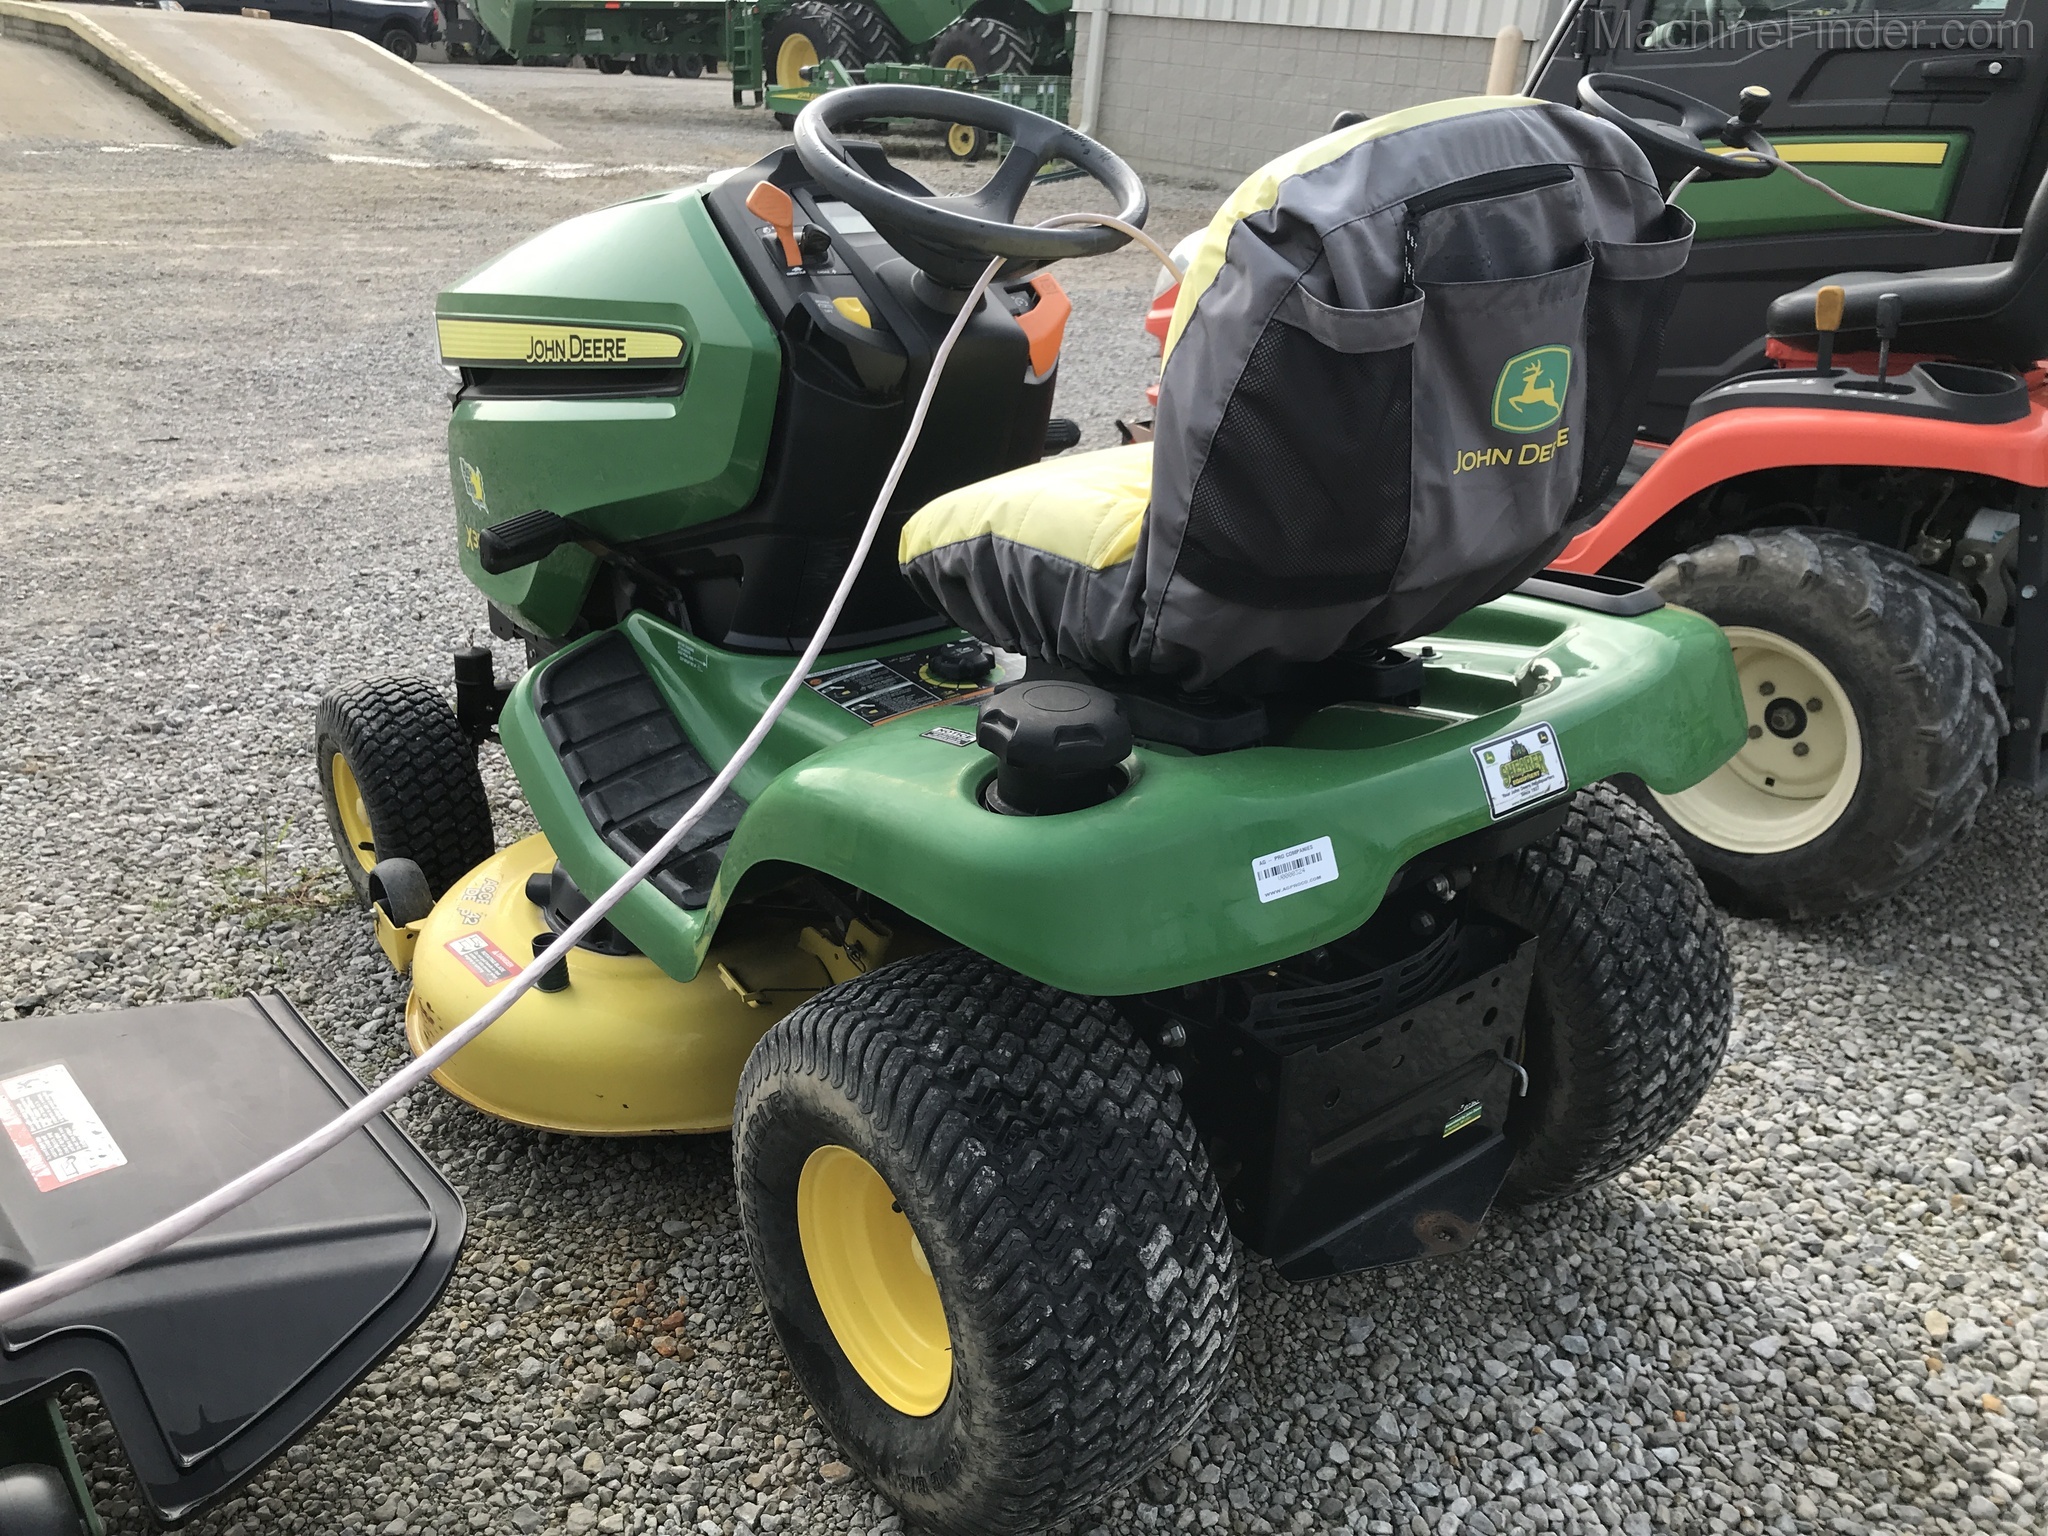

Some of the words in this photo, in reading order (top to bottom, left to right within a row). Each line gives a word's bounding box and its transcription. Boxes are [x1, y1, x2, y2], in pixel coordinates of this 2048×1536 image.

[526, 336, 566, 360] JOHN
[569, 334, 627, 360] DEERE
[1452, 448, 1513, 475] JOHN
[1517, 427, 1570, 466] DEE
[465, 523, 480, 552] X3
